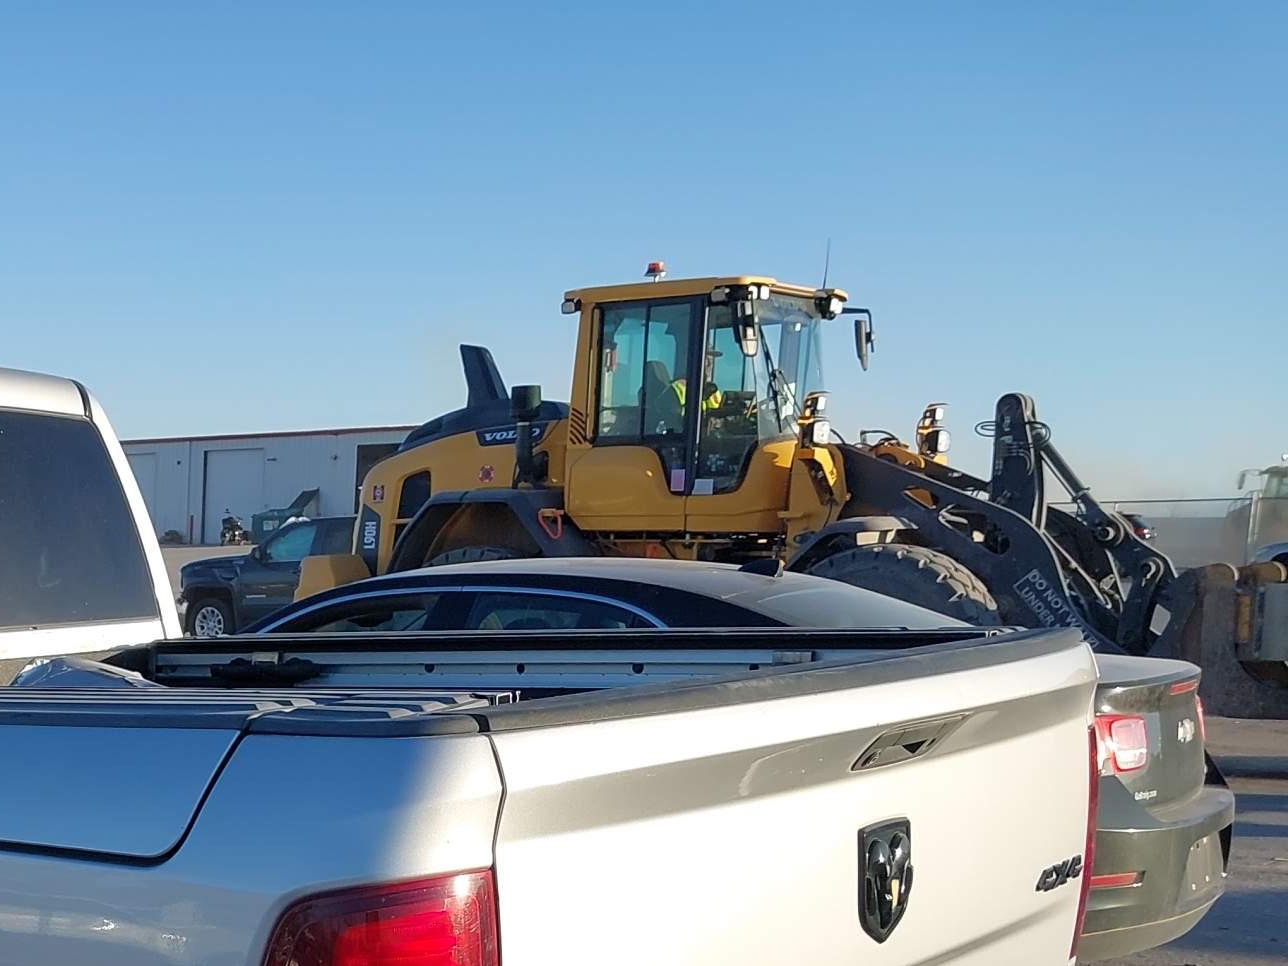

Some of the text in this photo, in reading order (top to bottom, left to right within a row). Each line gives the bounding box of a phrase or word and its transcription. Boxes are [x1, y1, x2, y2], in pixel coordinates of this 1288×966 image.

[483, 428, 541, 441] VOLO
[363, 521, 377, 550] L90H
[1022, 586, 1055, 628] UNDER
[1028, 570, 1047, 591] DO
[1043, 588, 1069, 614] NOT
